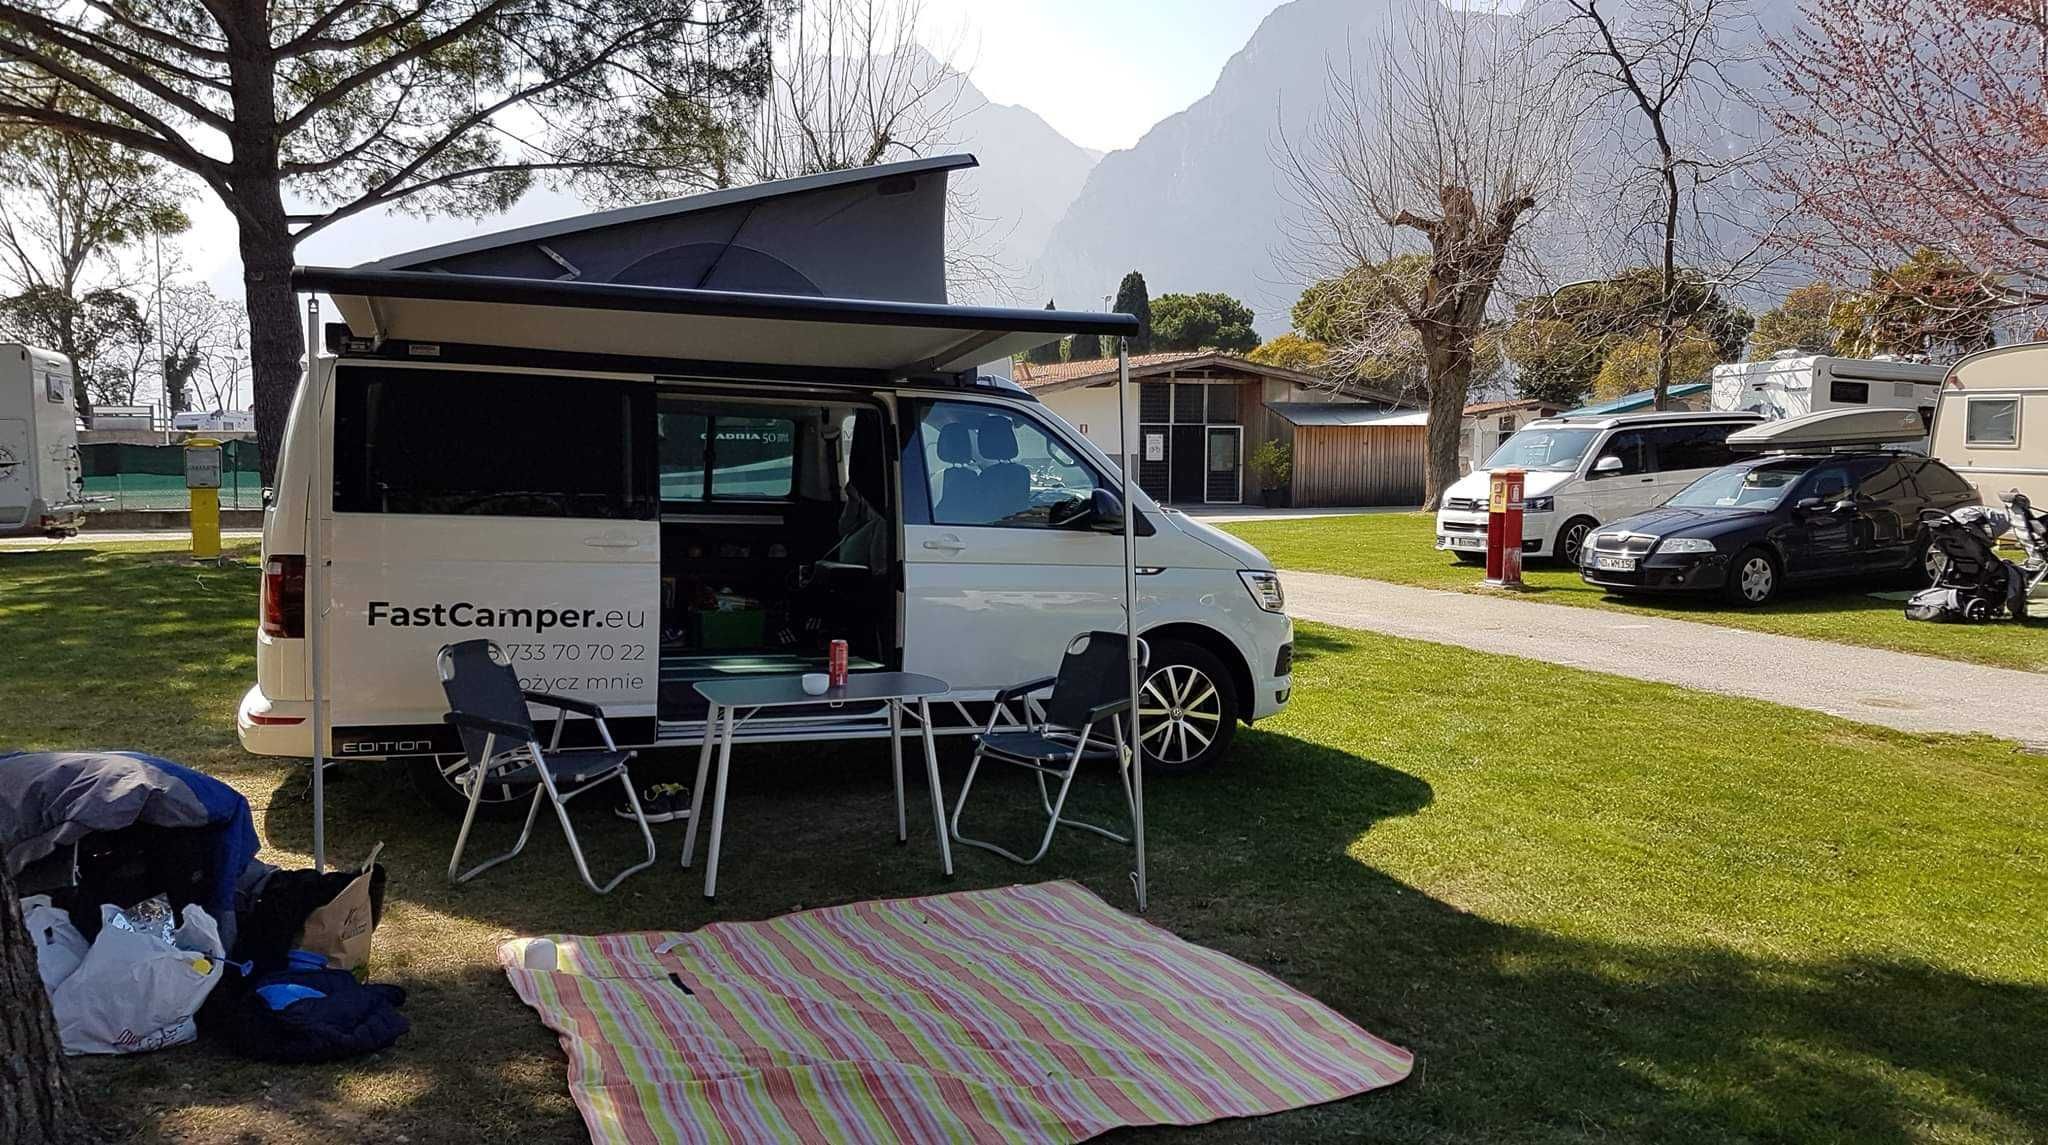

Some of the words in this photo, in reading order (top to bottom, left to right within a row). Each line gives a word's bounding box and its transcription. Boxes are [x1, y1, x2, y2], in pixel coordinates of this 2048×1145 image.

[715, 432, 761, 440] ADRIA
[368, 601, 645, 634] FastCamper.eu
[506, 643, 546, 661] 733
[552, 643, 581, 661] 70
[587, 643, 614, 661] 70
[620, 644, 645, 661] 22
[518, 673, 579, 695] ożycz
[586, 672, 644, 690] mnie
[342, 740, 432, 753] EDITION
